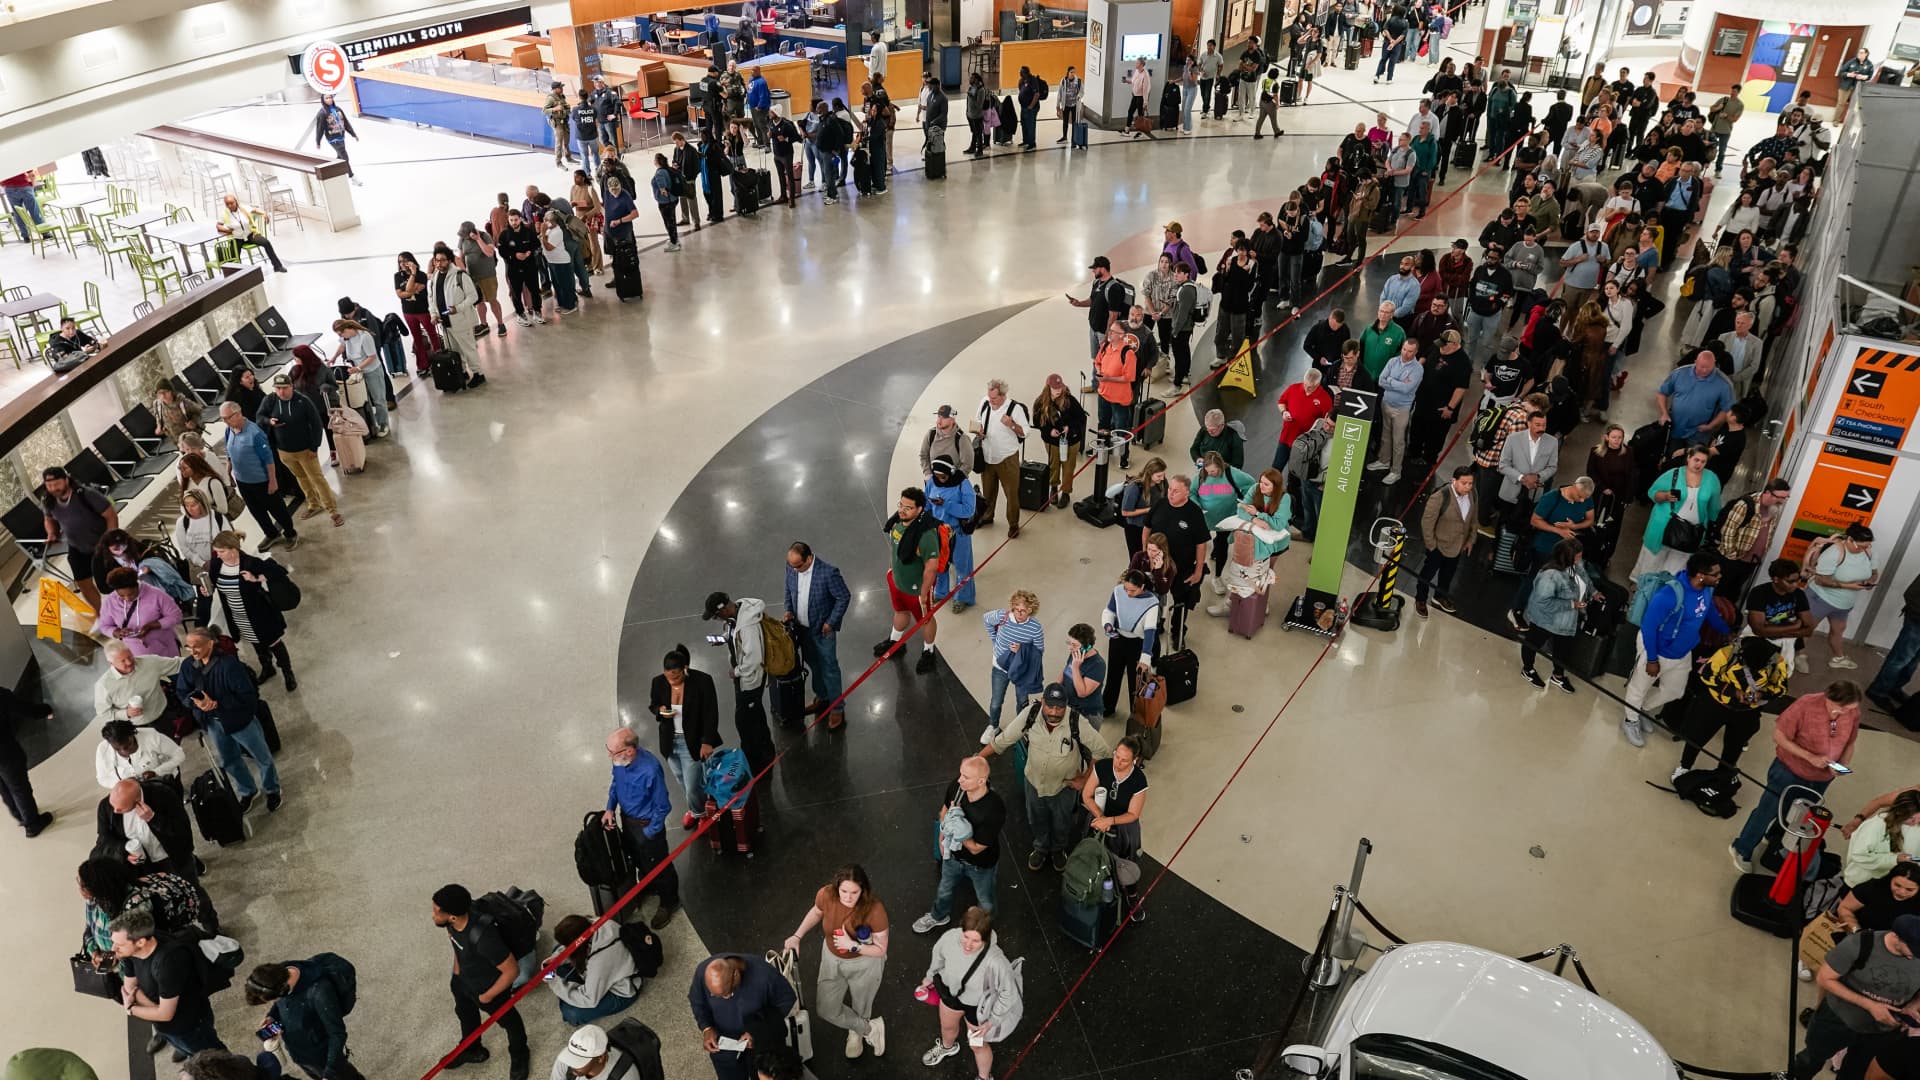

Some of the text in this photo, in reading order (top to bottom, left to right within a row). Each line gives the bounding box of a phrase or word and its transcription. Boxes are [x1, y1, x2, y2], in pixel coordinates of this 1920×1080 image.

[345, 22, 463, 56] TERMINAL SOUTH
[319, 53, 340, 81] S
[581, 116, 594, 124] HSI
[1858, 400, 1885, 410] South
[1855, 408, 1905, 424] Checkpoint
[1841, 430, 1860, 438] CLEAR
[1338, 443, 1355, 492] All Gates
[1829, 507, 1854, 517] North
